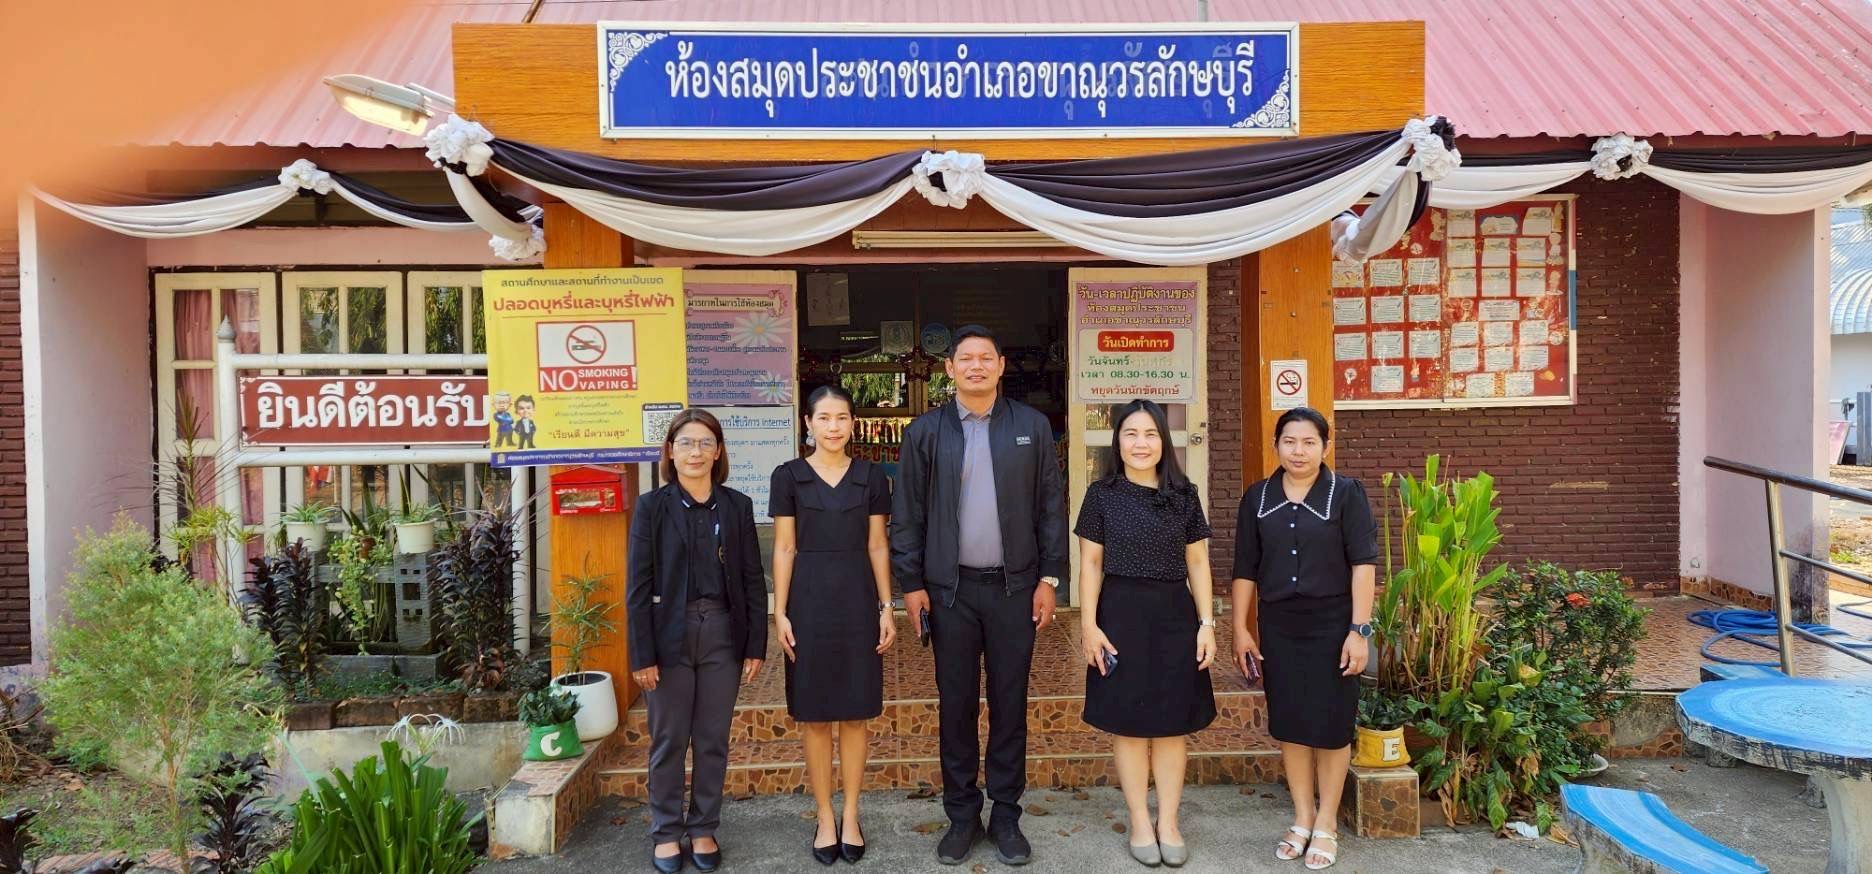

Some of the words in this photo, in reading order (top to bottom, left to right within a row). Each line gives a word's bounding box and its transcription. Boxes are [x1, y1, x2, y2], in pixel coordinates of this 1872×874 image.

[664, 39, 1255, 118] ห้องสมุดประชาชนอำเภอขาณุวรลักษบุรี
[501, 274, 664, 288] สถานศึกษาและสถานที่ทำงานเป็นเขต
[493, 289, 675, 314] ปลอดบุหรี่และบุหรี่ไฟฟ้า
[1103, 335, 1169, 348] วันเปิดทำการ
[540, 369, 578, 392] NO
[578, 368, 629, 378] SMOKING
[579, 380, 629, 390] VAPING
[1081, 371, 1105, 379] เวลา
[1110, 371, 1174, 379] 08.30-16.30
[1091, 384, 1181, 397] หยุดวันนักขัตฤกษ์
[257, 381, 490, 428] ยินดีต้อนรับ
[540, 731, 562, 757] C
[1383, 737, 1401, 762] E
